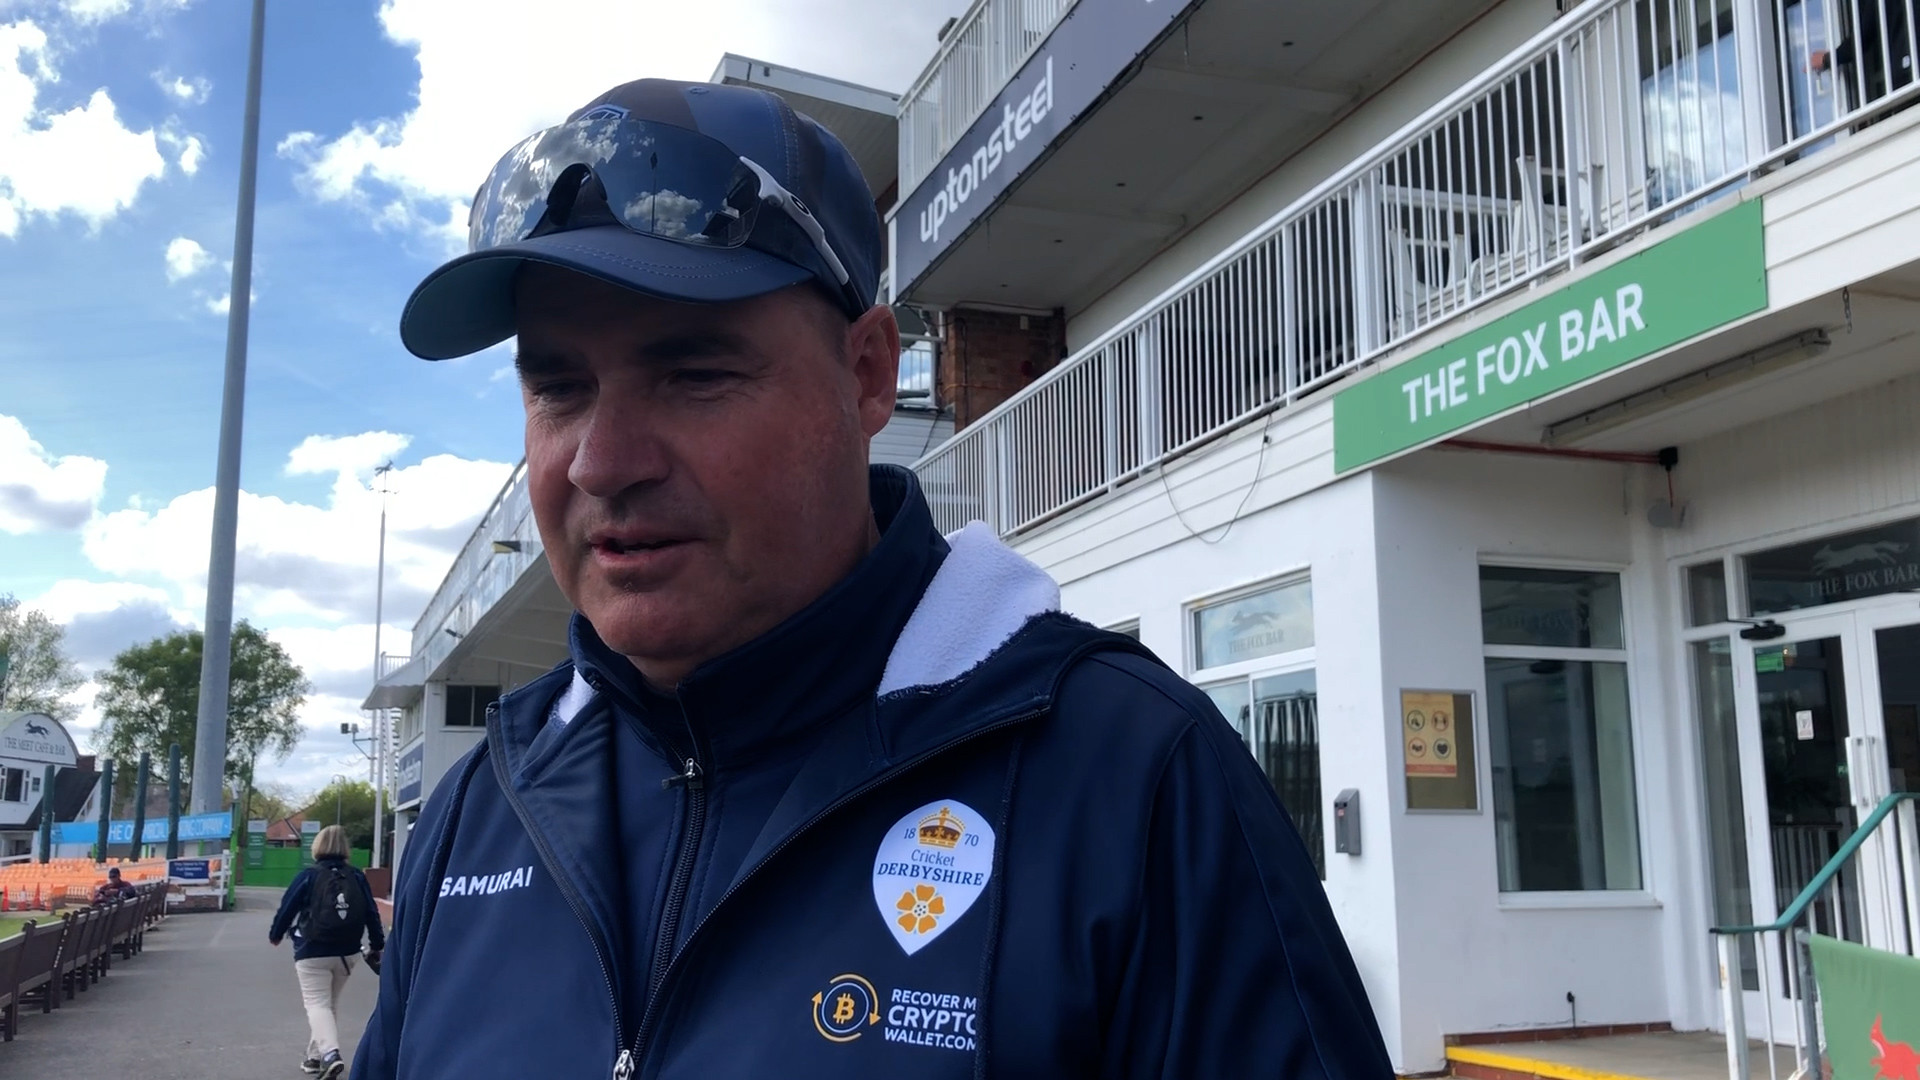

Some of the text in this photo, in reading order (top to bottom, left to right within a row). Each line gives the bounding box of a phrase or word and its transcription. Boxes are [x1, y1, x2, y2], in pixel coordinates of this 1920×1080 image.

[920, 55, 1053, 243] uptonsteel
[1402, 283, 1646, 424] THE FOX BAR
[1809, 563, 1920, 598] THE FOX BAR
[1266, 628, 1285, 646] BAR
[904, 828, 979, 847] 18 70
[911, 849, 956, 867] Cricket
[439, 866, 533, 898] SAMURAI
[877, 863, 985, 887] DERBYSHIRE
[891, 988, 960, 1009] RECOVER
[884, 1026, 977, 1051] WALLET.COM
